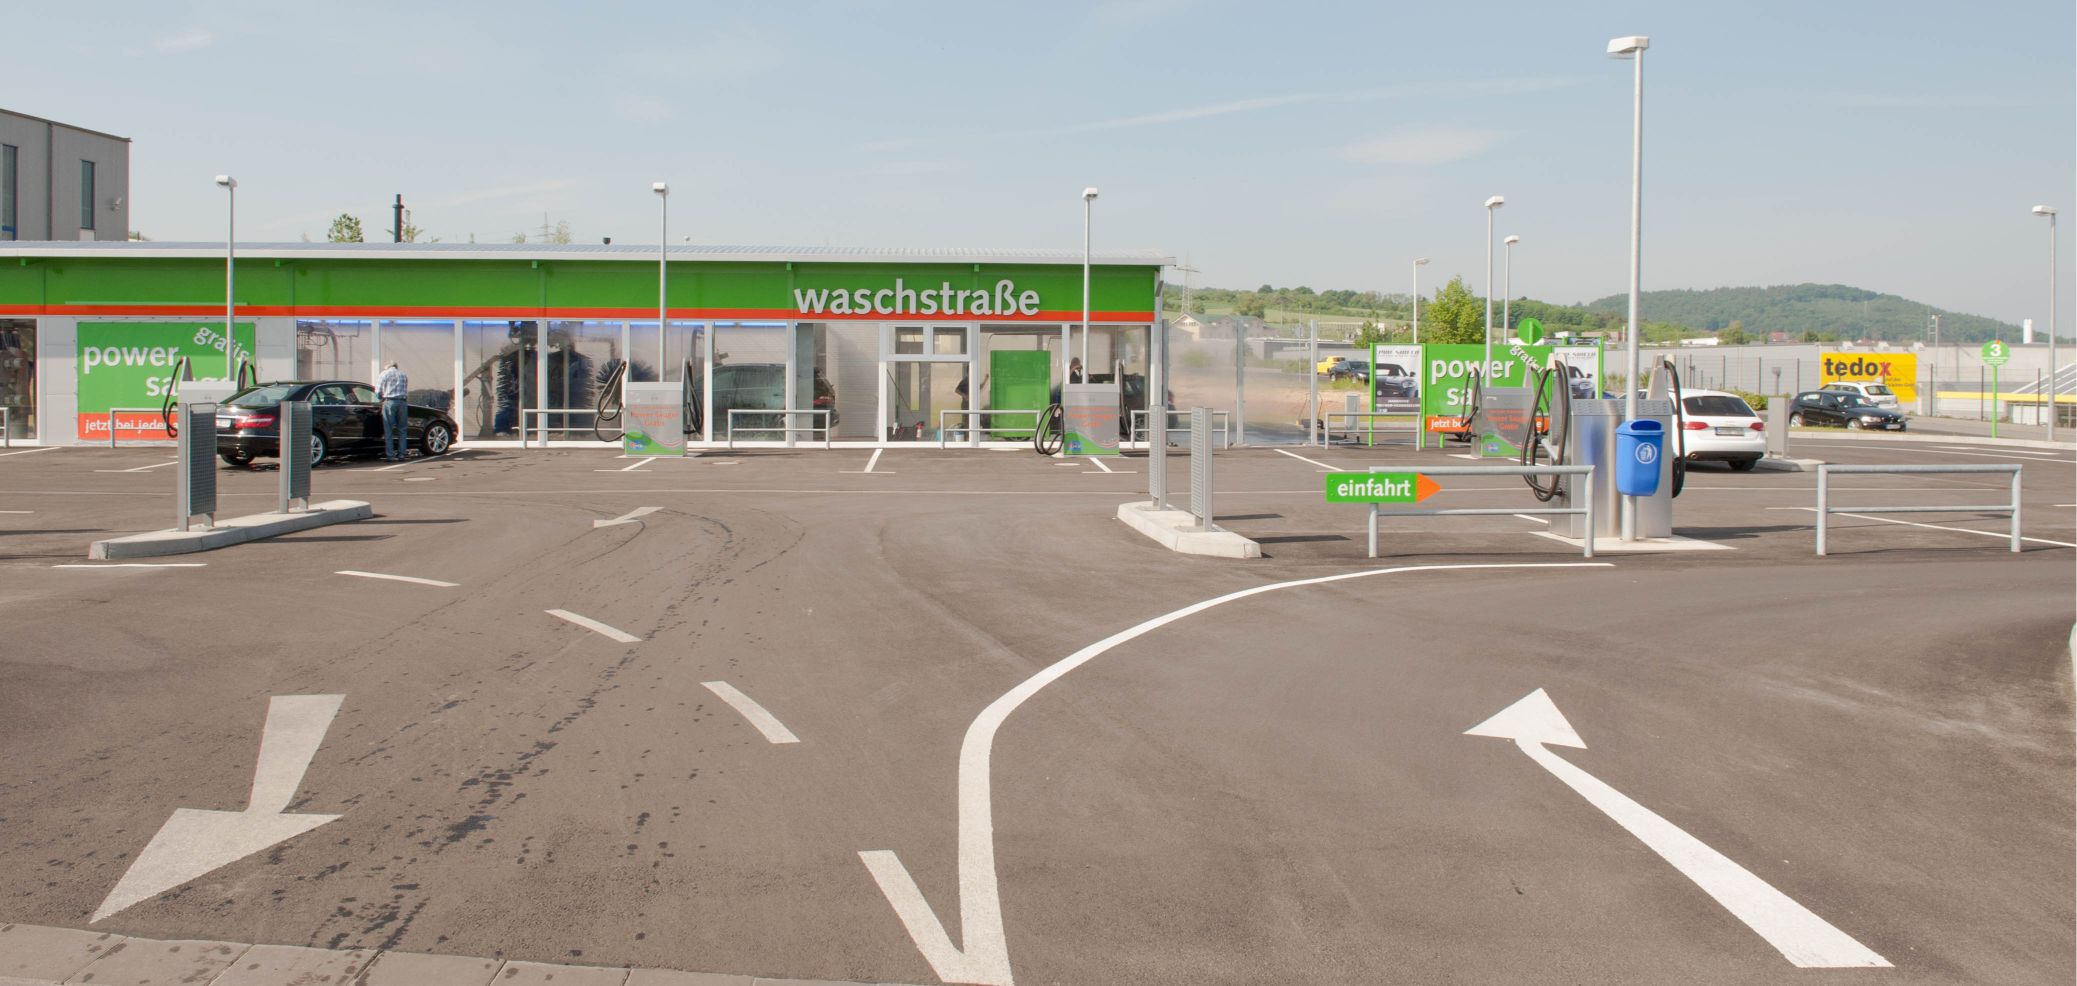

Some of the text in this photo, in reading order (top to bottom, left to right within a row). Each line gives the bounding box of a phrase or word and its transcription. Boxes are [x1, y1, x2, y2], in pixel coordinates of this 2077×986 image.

[794, 278, 1040, 316] waschstraße
[1990, 343, 2002, 357] 3
[84, 346, 179, 374] power
[1824, 357, 1892, 376] tedox
[1431, 359, 1514, 385] power
[1430, 419, 1450, 430] jetzt
[1337, 478, 1411, 497] einfahrt
